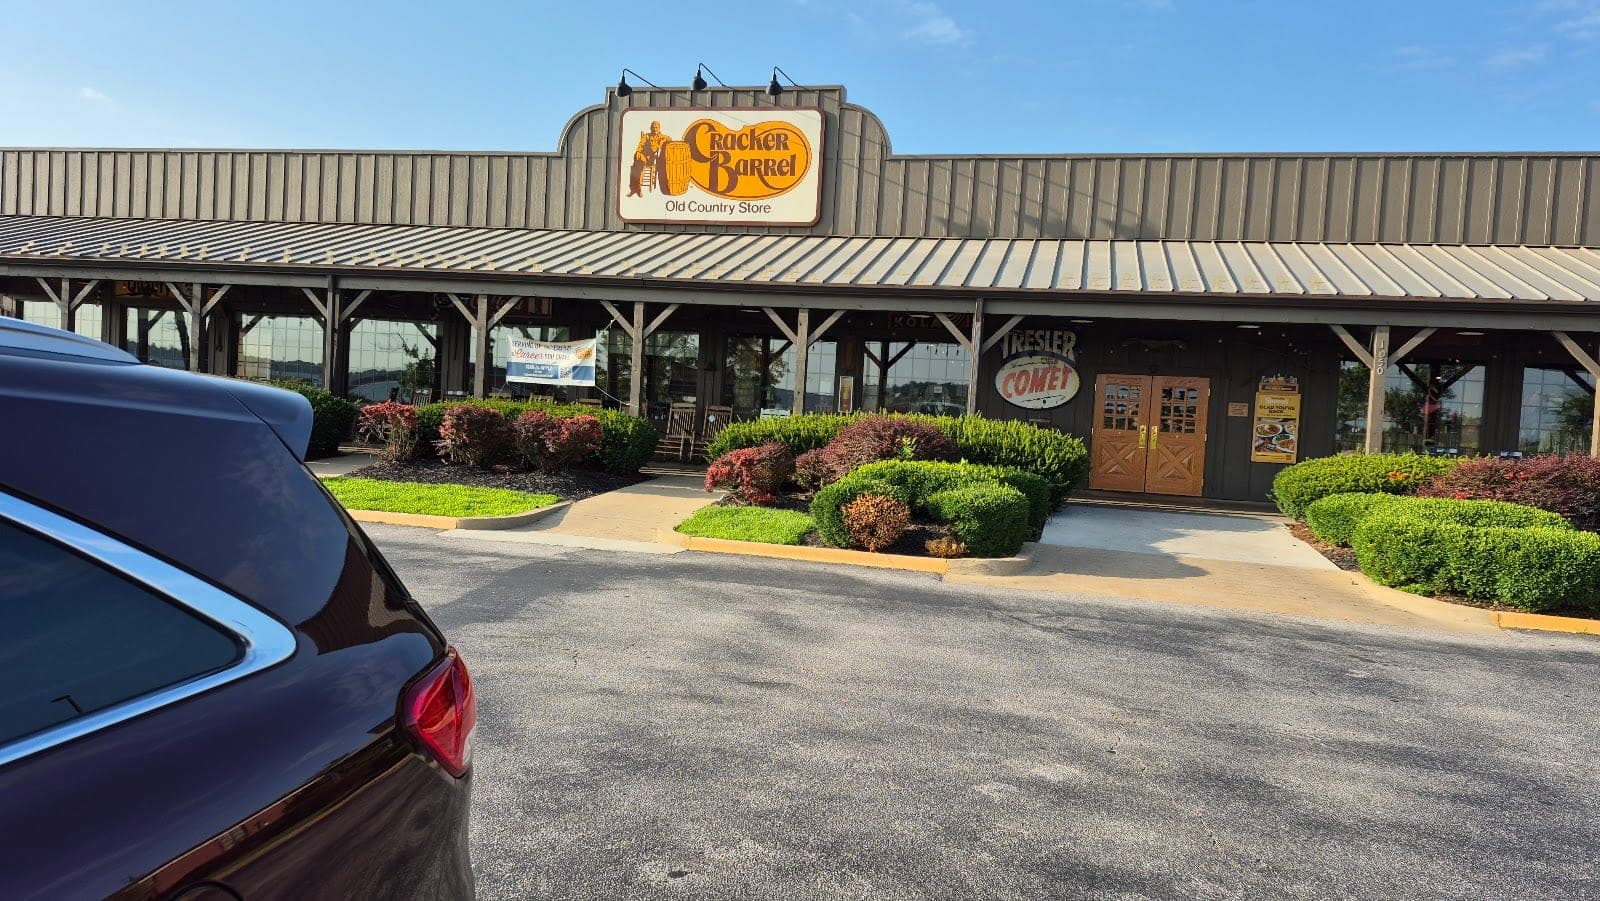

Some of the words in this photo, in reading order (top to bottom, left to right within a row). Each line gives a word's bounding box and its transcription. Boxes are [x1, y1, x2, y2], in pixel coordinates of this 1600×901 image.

[684, 122, 790, 163] Cracker
[708, 150, 797, 195] Barrel
[665, 200, 685, 212] Old
[688, 201, 735, 215] Country
[738, 201, 771, 214] Store
[1001, 366, 1073, 400] COMET
